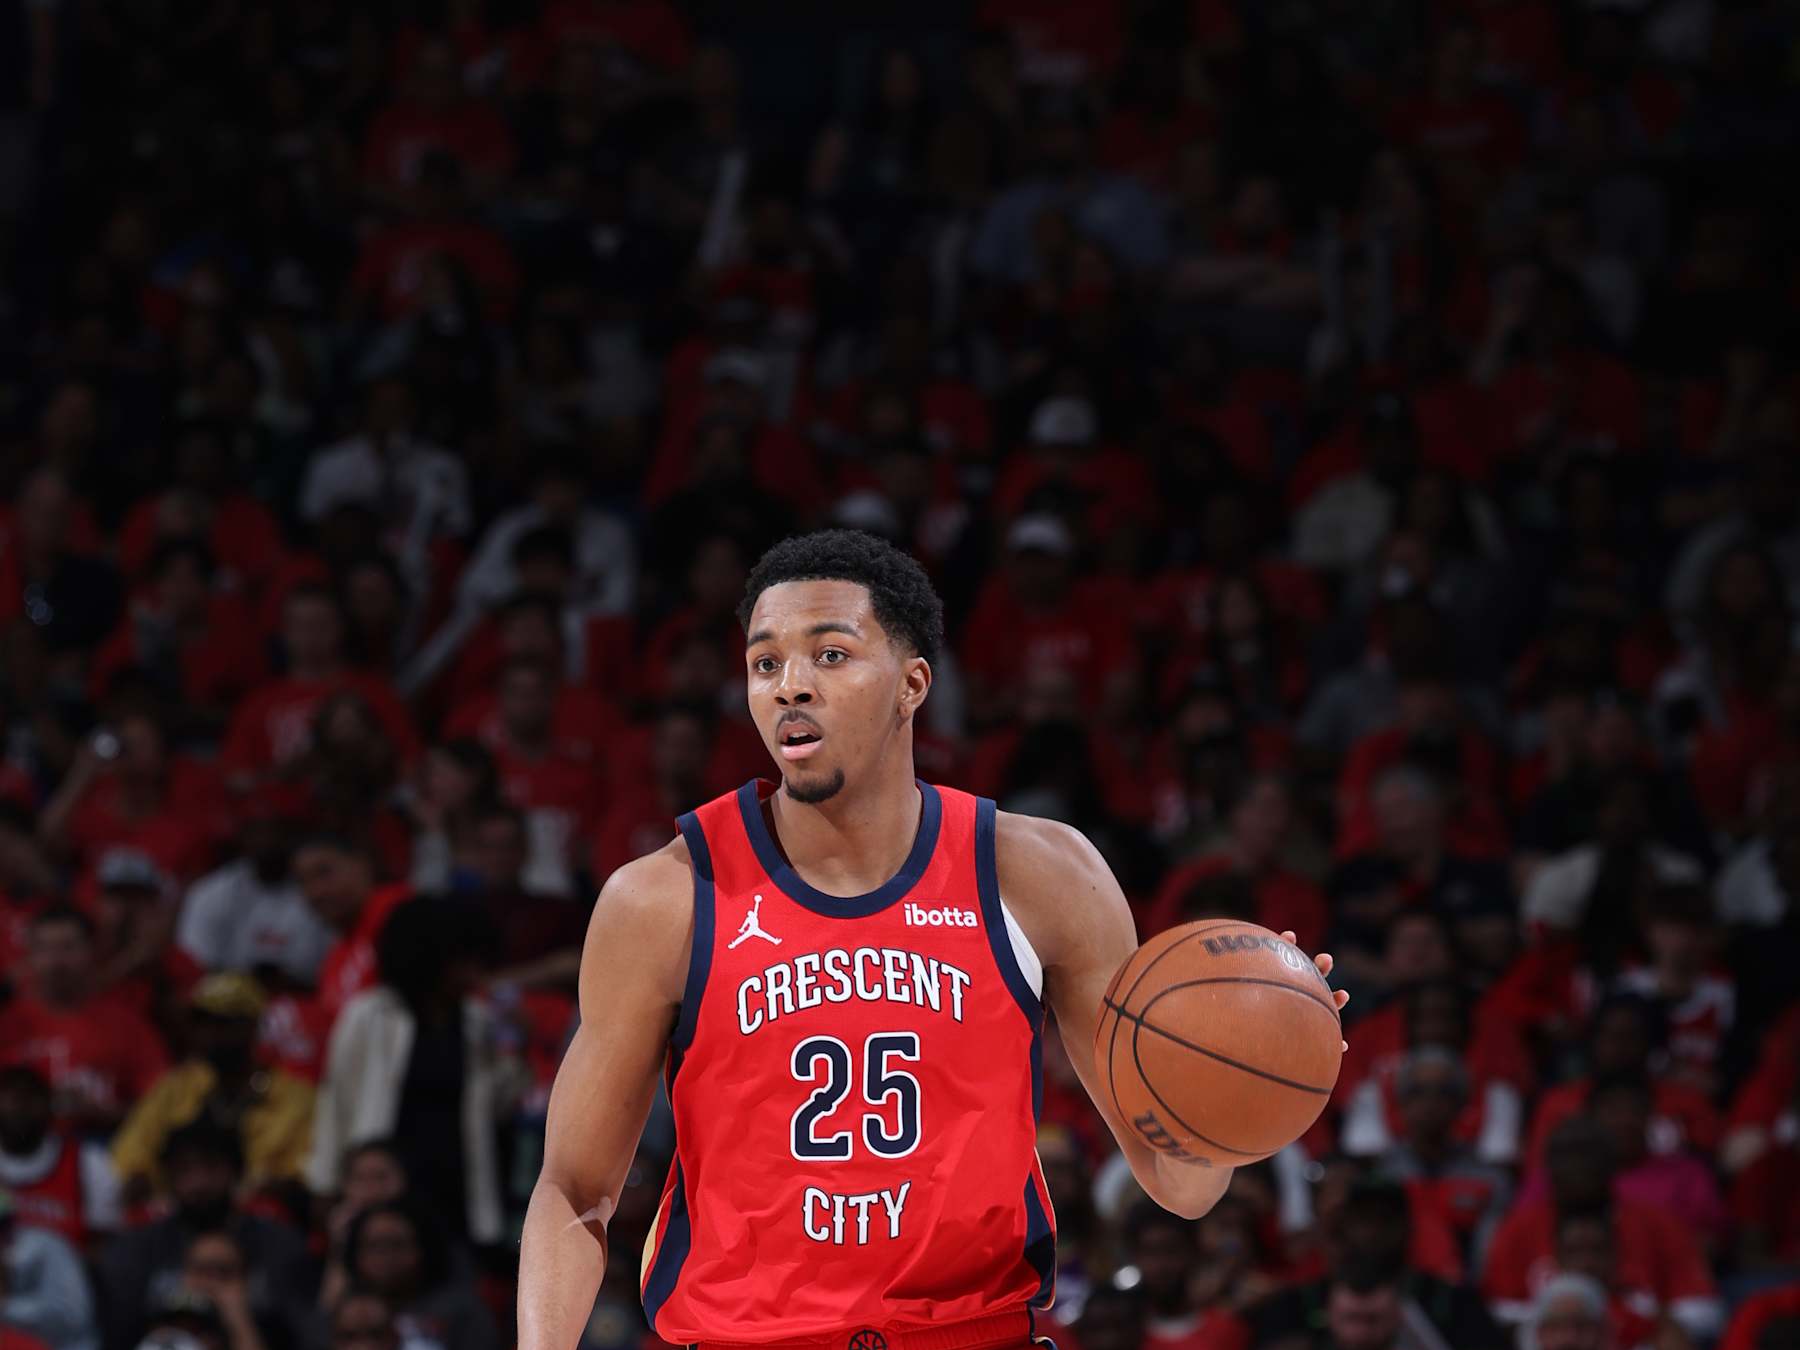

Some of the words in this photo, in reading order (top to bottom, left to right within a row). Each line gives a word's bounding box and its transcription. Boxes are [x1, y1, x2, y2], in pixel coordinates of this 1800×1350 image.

[904, 903, 978, 927] ibotta
[737, 947, 972, 1035] CRESCENT
[790, 1031, 922, 1161] 25
[802, 1181, 911, 1245] CITY
